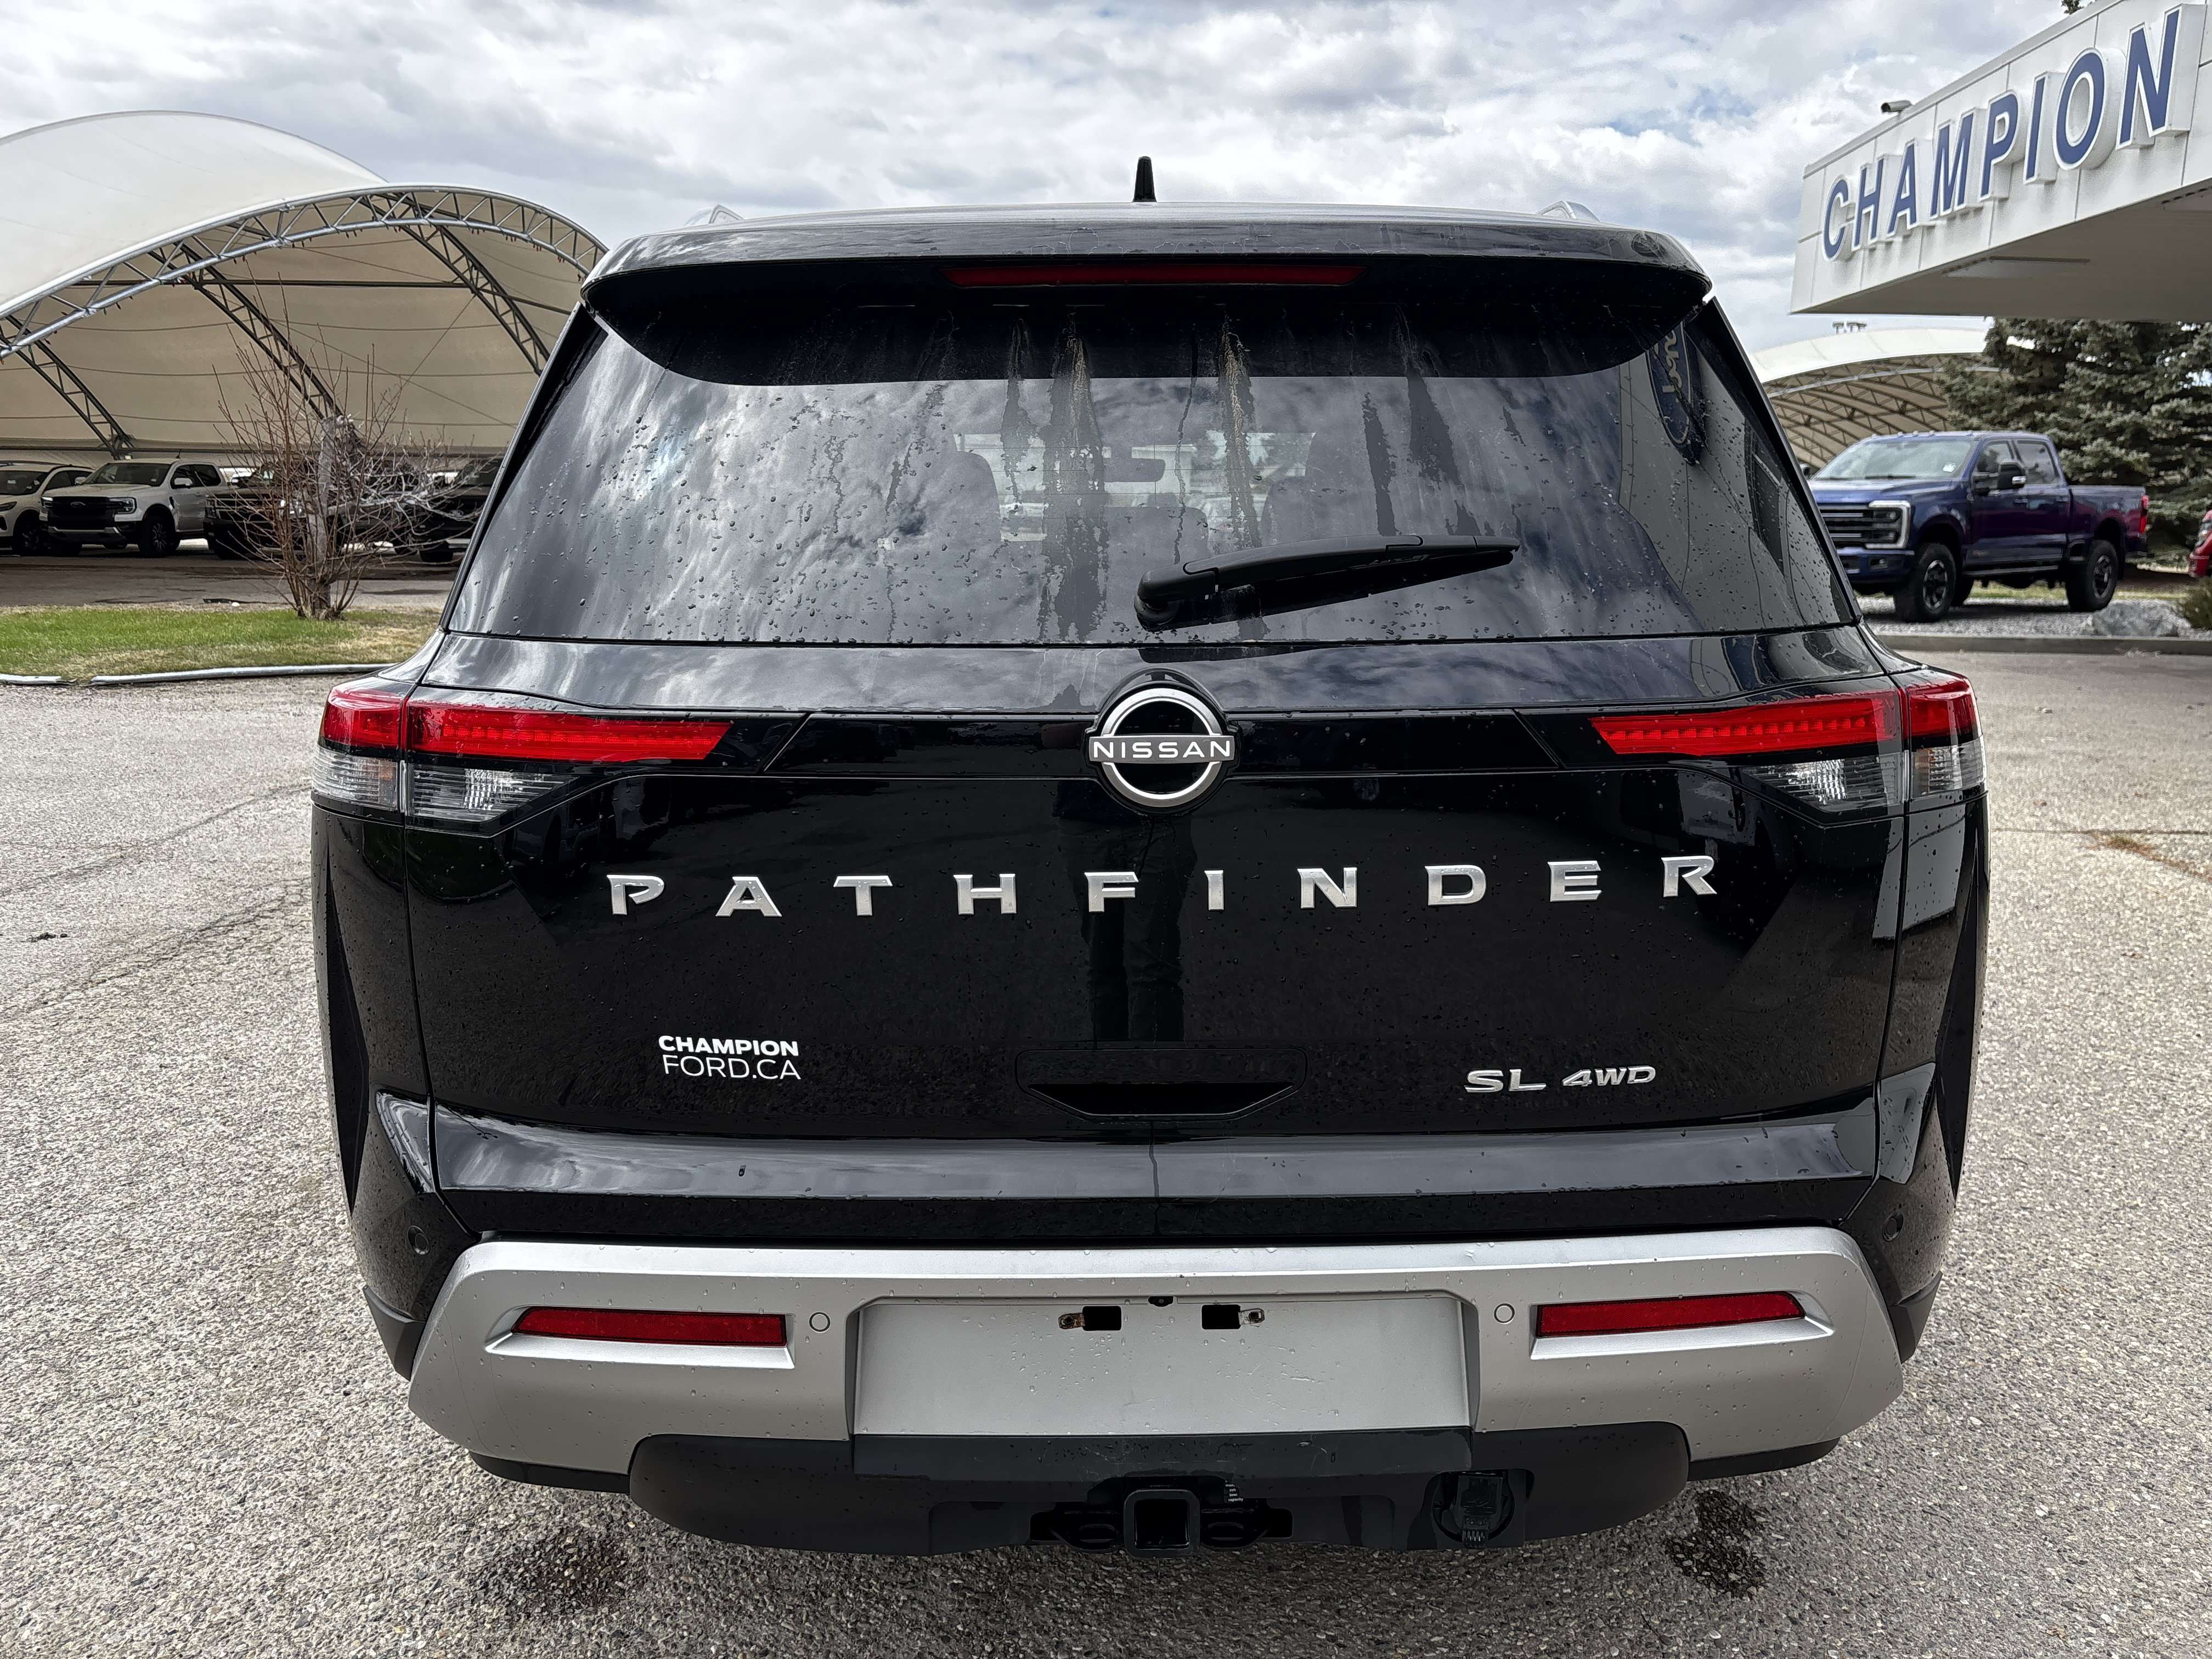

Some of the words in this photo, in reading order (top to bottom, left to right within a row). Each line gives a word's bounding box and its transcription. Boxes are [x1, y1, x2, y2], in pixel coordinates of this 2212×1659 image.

[1822, 4, 2185, 261] CHAMPION
[1093, 740, 1230, 758] NISSAN
[606, 855, 1718, 918] PATHFINDER
[658, 1035, 799, 1056] CHAMPION
[662, 1054, 802, 1080] FORD.CA
[1464, 1068, 1547, 1093] SL
[1562, 1065, 1656, 1087] 4WD
